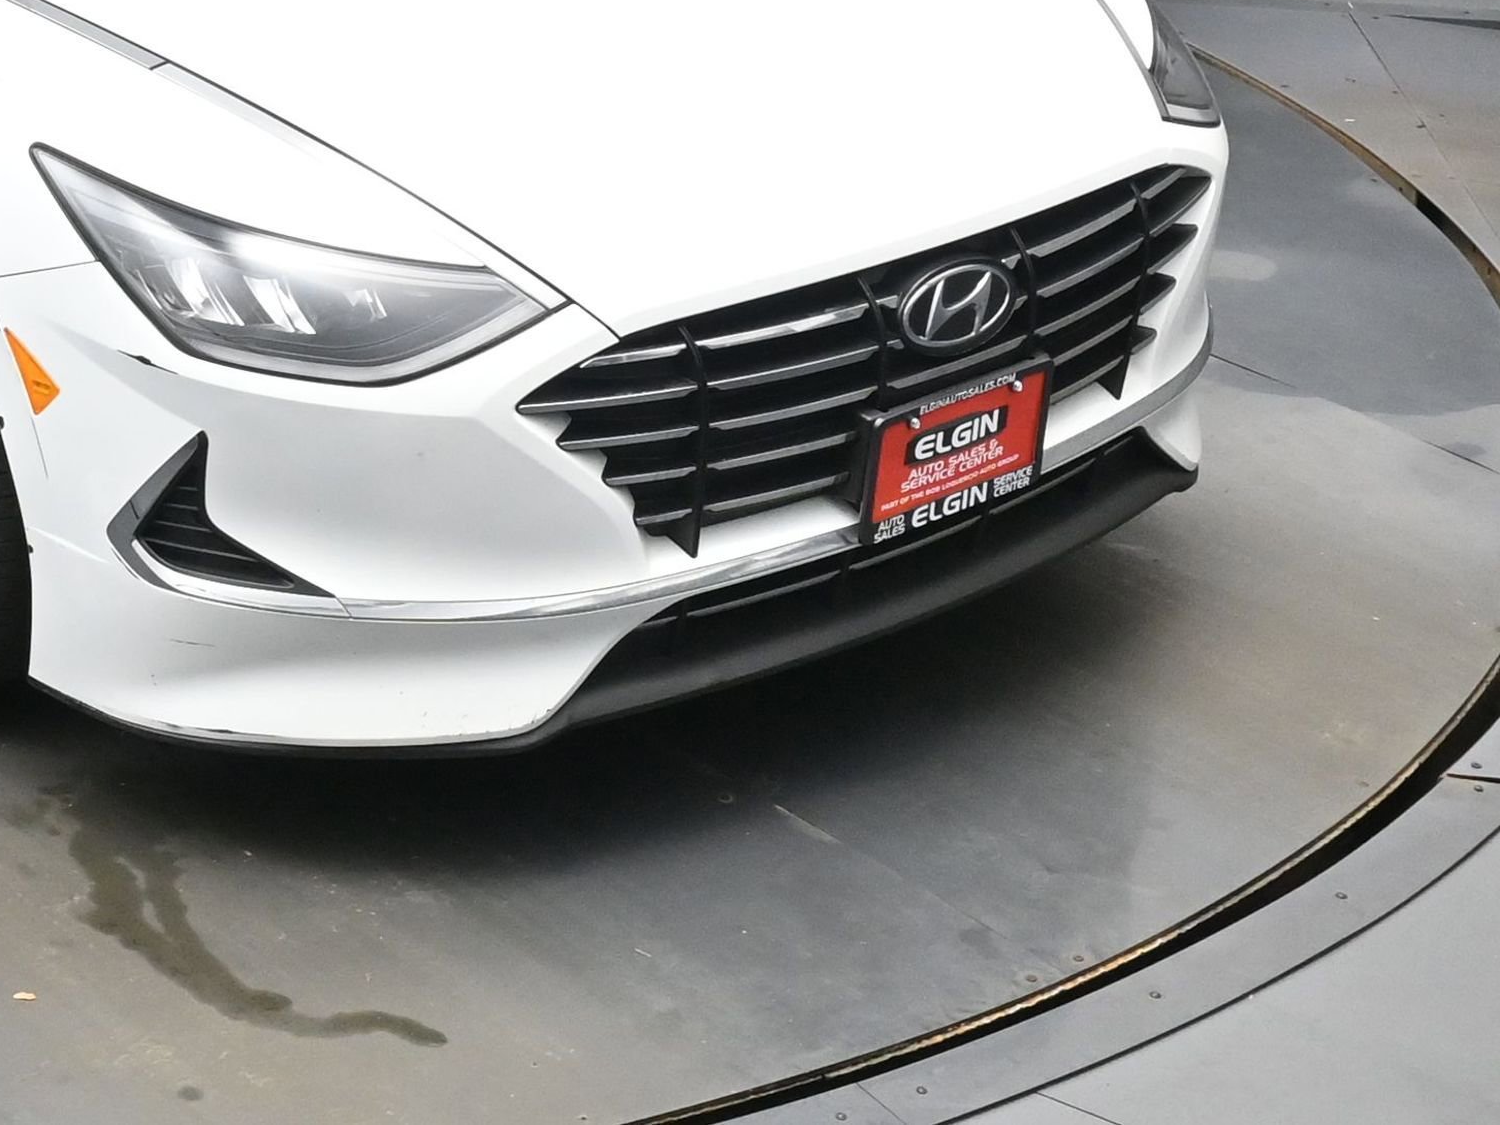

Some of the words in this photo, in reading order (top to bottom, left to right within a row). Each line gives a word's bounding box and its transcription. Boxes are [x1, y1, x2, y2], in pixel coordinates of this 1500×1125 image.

[914, 408, 1000, 460] ELGIN
[900, 464, 955, 493] SERVICE
[959, 446, 1004, 472] CENTER
[908, 461, 945, 480] AUTO
[948, 443, 986, 466] SALES
[993, 465, 1033, 489] SERVICE
[993, 476, 1030, 498] CENTER
[911, 481, 989, 529] ELGIN
[873, 523, 906, 544] SALES
[877, 514, 905, 532] AUTO
